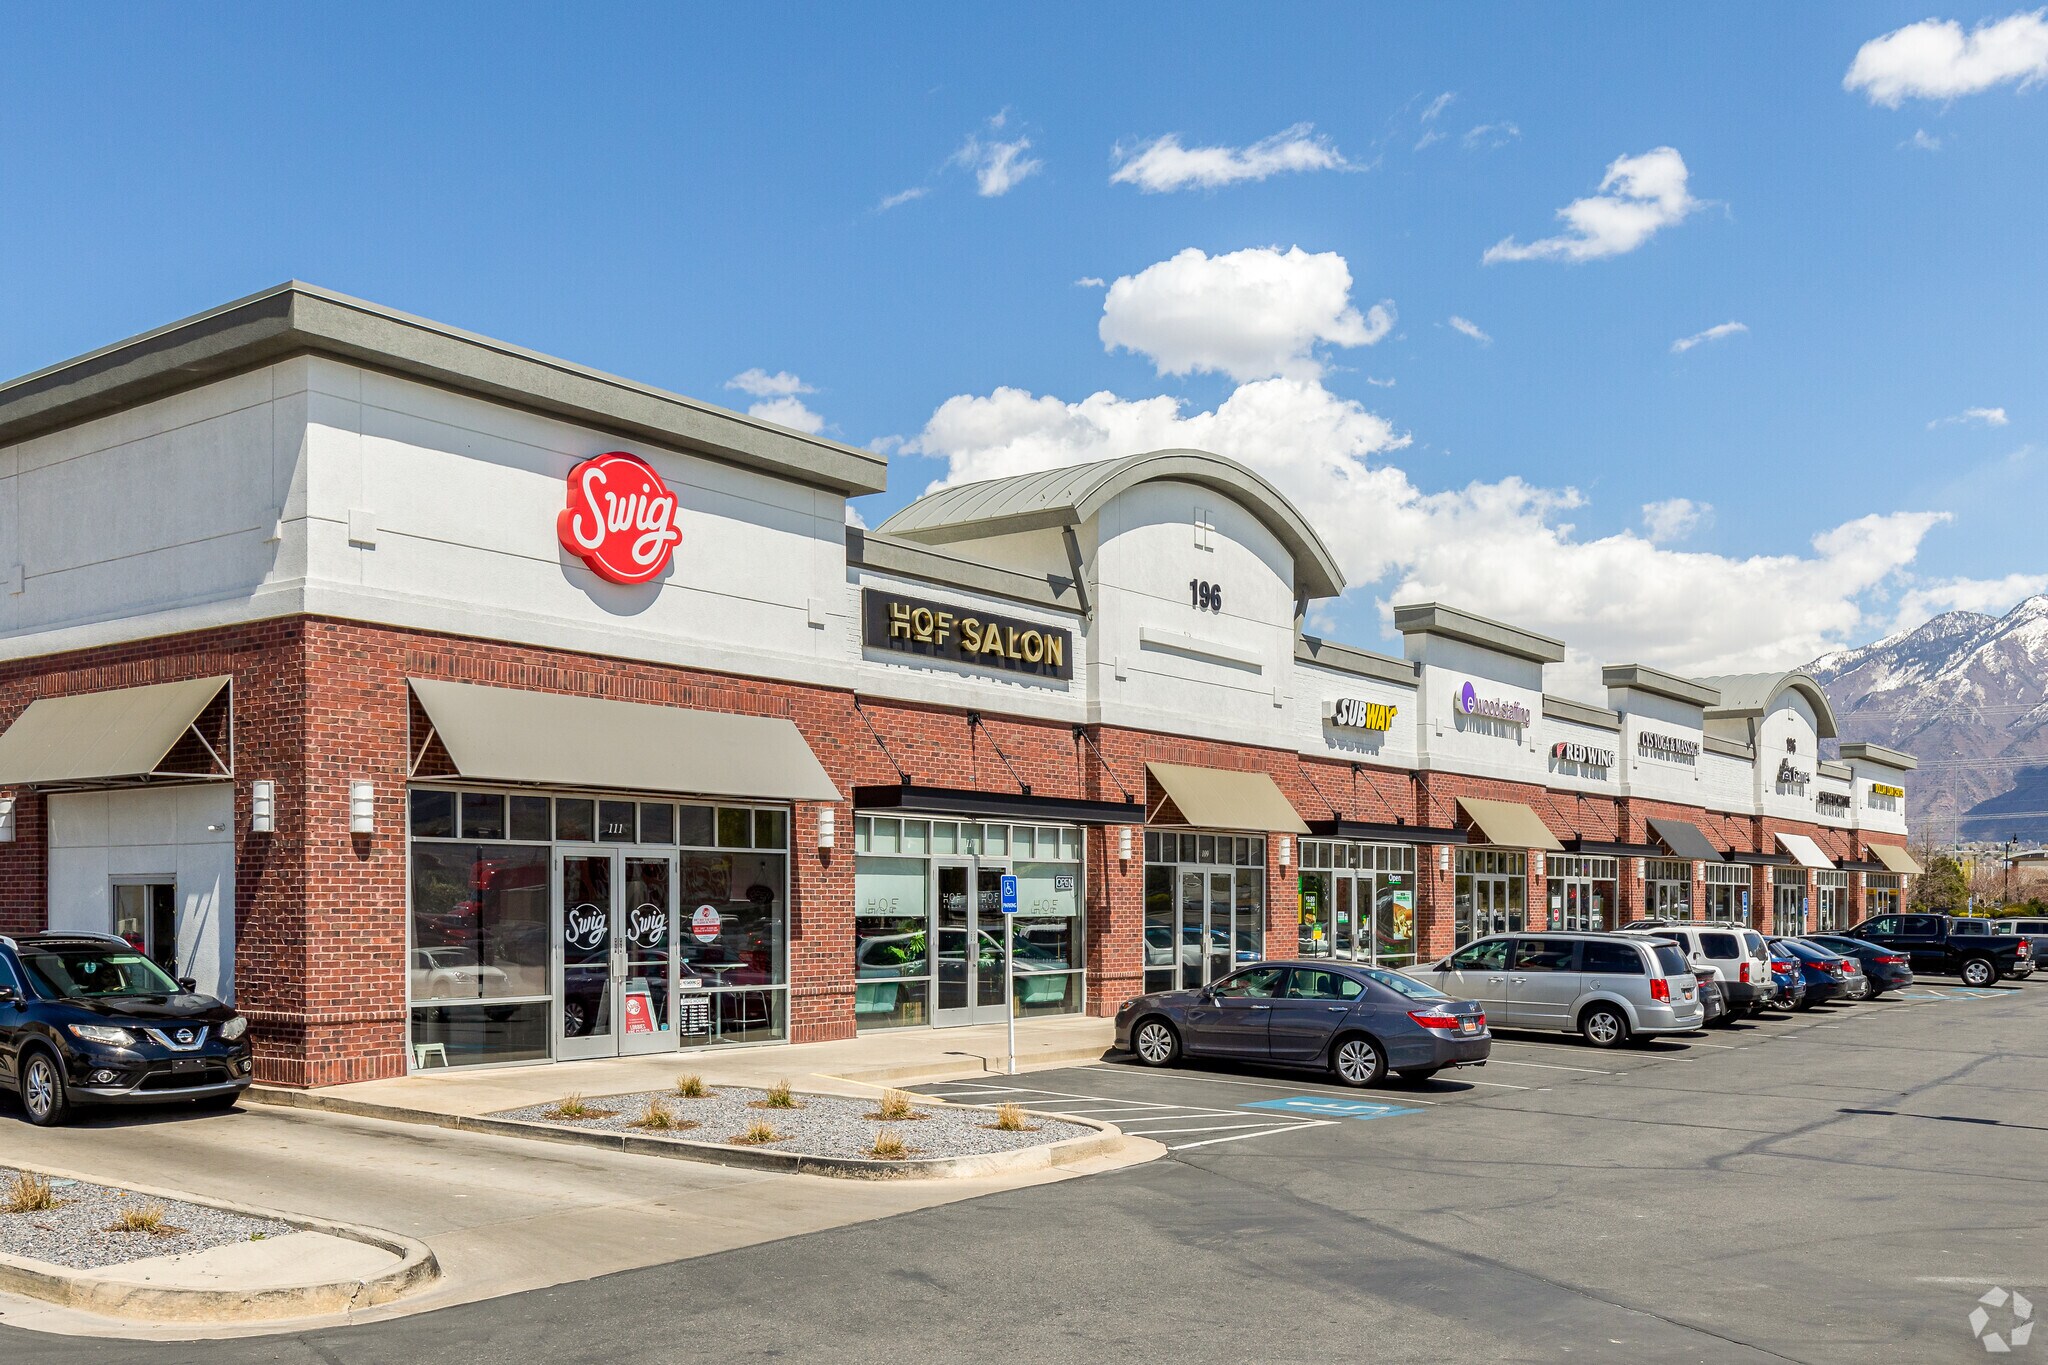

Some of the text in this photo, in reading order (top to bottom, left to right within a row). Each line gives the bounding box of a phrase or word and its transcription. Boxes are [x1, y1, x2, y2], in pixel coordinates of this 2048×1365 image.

[572, 467, 678, 566] Swig
[1190, 579, 1222, 611] 196
[889, 602, 1063, 667] HOF SALON
[1333, 698, 1398, 732] SUBWAY
[1501, 700, 1531, 729] staffing
[1565, 742, 1616, 768] RED WING
[1654, 733, 1670, 751] YOGA
[1670, 736, 1676, 752] &
[608, 823, 623, 834] 111
[1056, 878, 1074, 887] OPEN
[1388, 873, 1402, 883] Open
[981, 893, 999, 903] HOF
[566, 909, 608, 944] Swig
[627, 909, 667, 943] Swig
